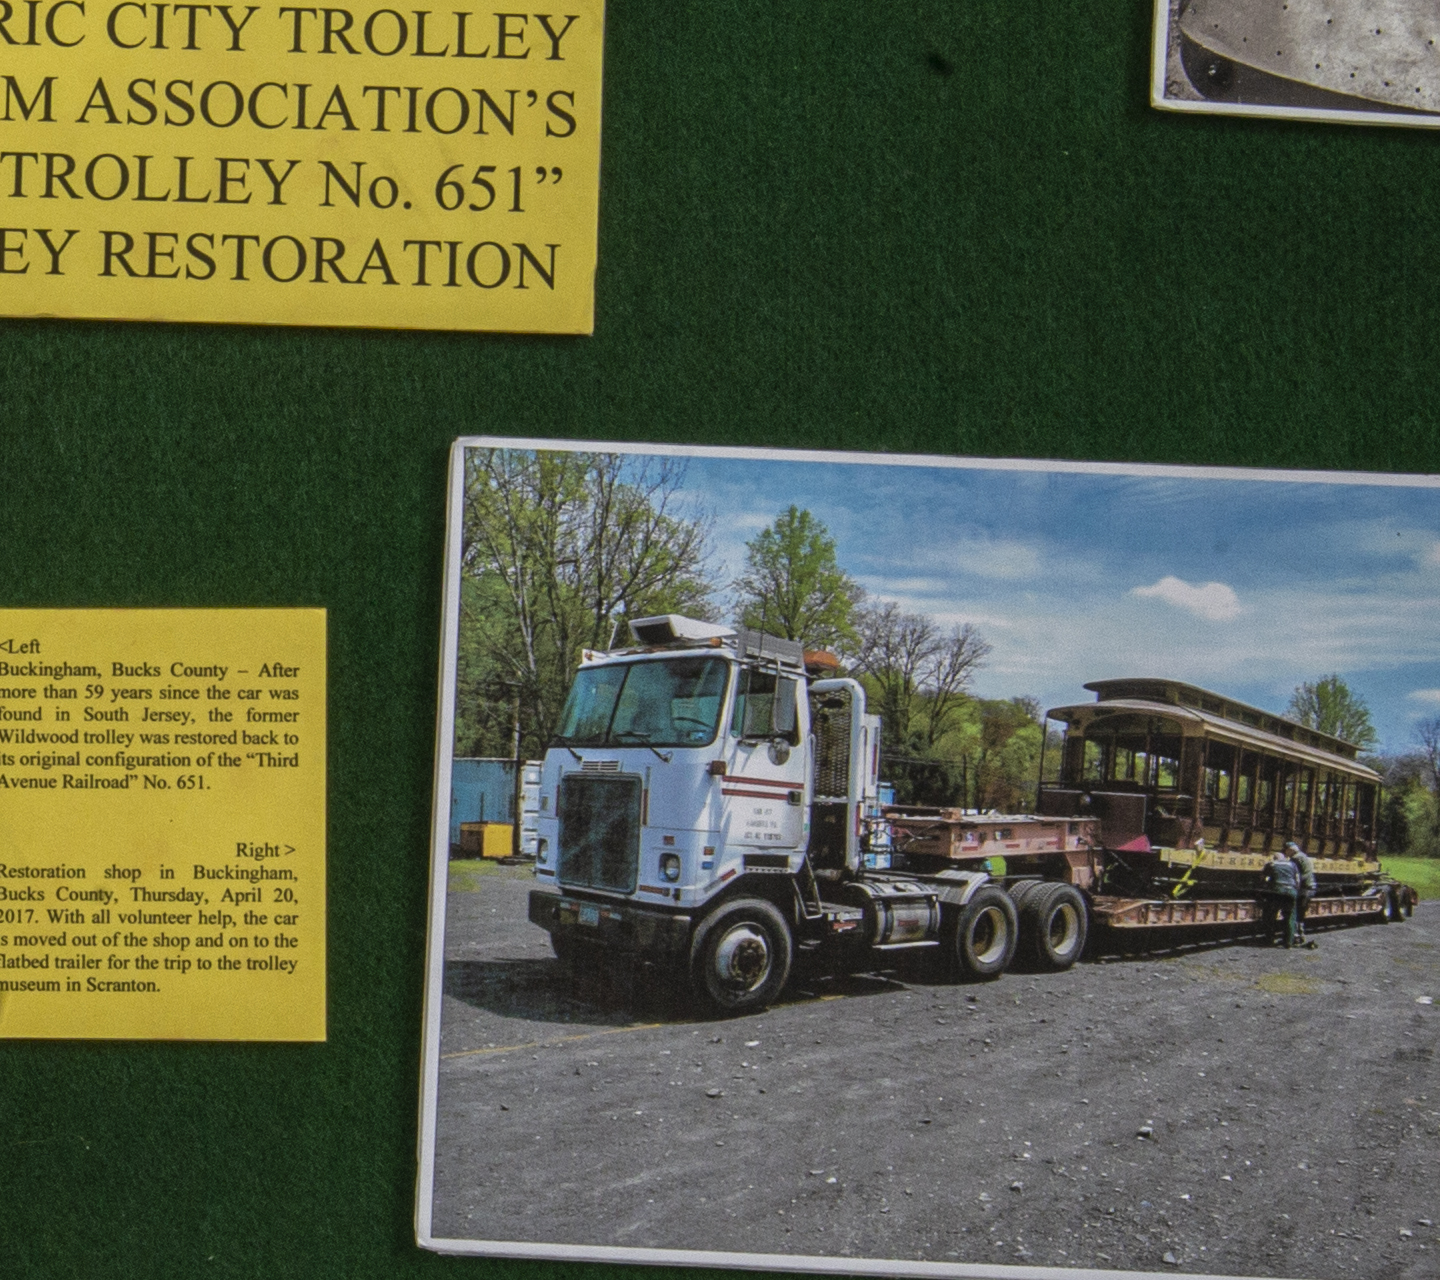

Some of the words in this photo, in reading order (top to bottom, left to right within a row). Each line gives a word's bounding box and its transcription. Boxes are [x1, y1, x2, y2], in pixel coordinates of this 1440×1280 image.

[107, 2, 260, 51] CITY
[279, 7, 579, 60] TROLLEY
[75, 77, 576, 138] ASSOCIATION’S
[0, 151, 301, 205] TROLLEY
[318, 160, 412, 210] No.
[435, 164, 563, 212] 651”
[99, 231, 560, 290] RESTORATION
[56, 706, 70, 721] in
[84, 706, 129, 722] South
[142, 707, 195, 726] Jersey,
[208, 707, 233, 722] the
[246, 707, 300, 723] former
[83, 729, 134, 748] trolley
[139, 734, 170, 744] was
[174, 730, 237, 745] restored
[242, 730, 278, 745] back
[284, 733, 299, 745] to
[62, 774, 138, 789] Railroad”
[144, 775, 171, 790] No.
[176, 774, 210, 790] 651.
[104, 864, 142, 883] shop
[160, 864, 175, 879] in
[193, 864, 298, 884] Buckingham,
[55, 886, 118, 906] County,
[130, 887, 209, 906] Thursday,
[221, 888, 261, 906] April
[274, 887, 298, 904] 20,
